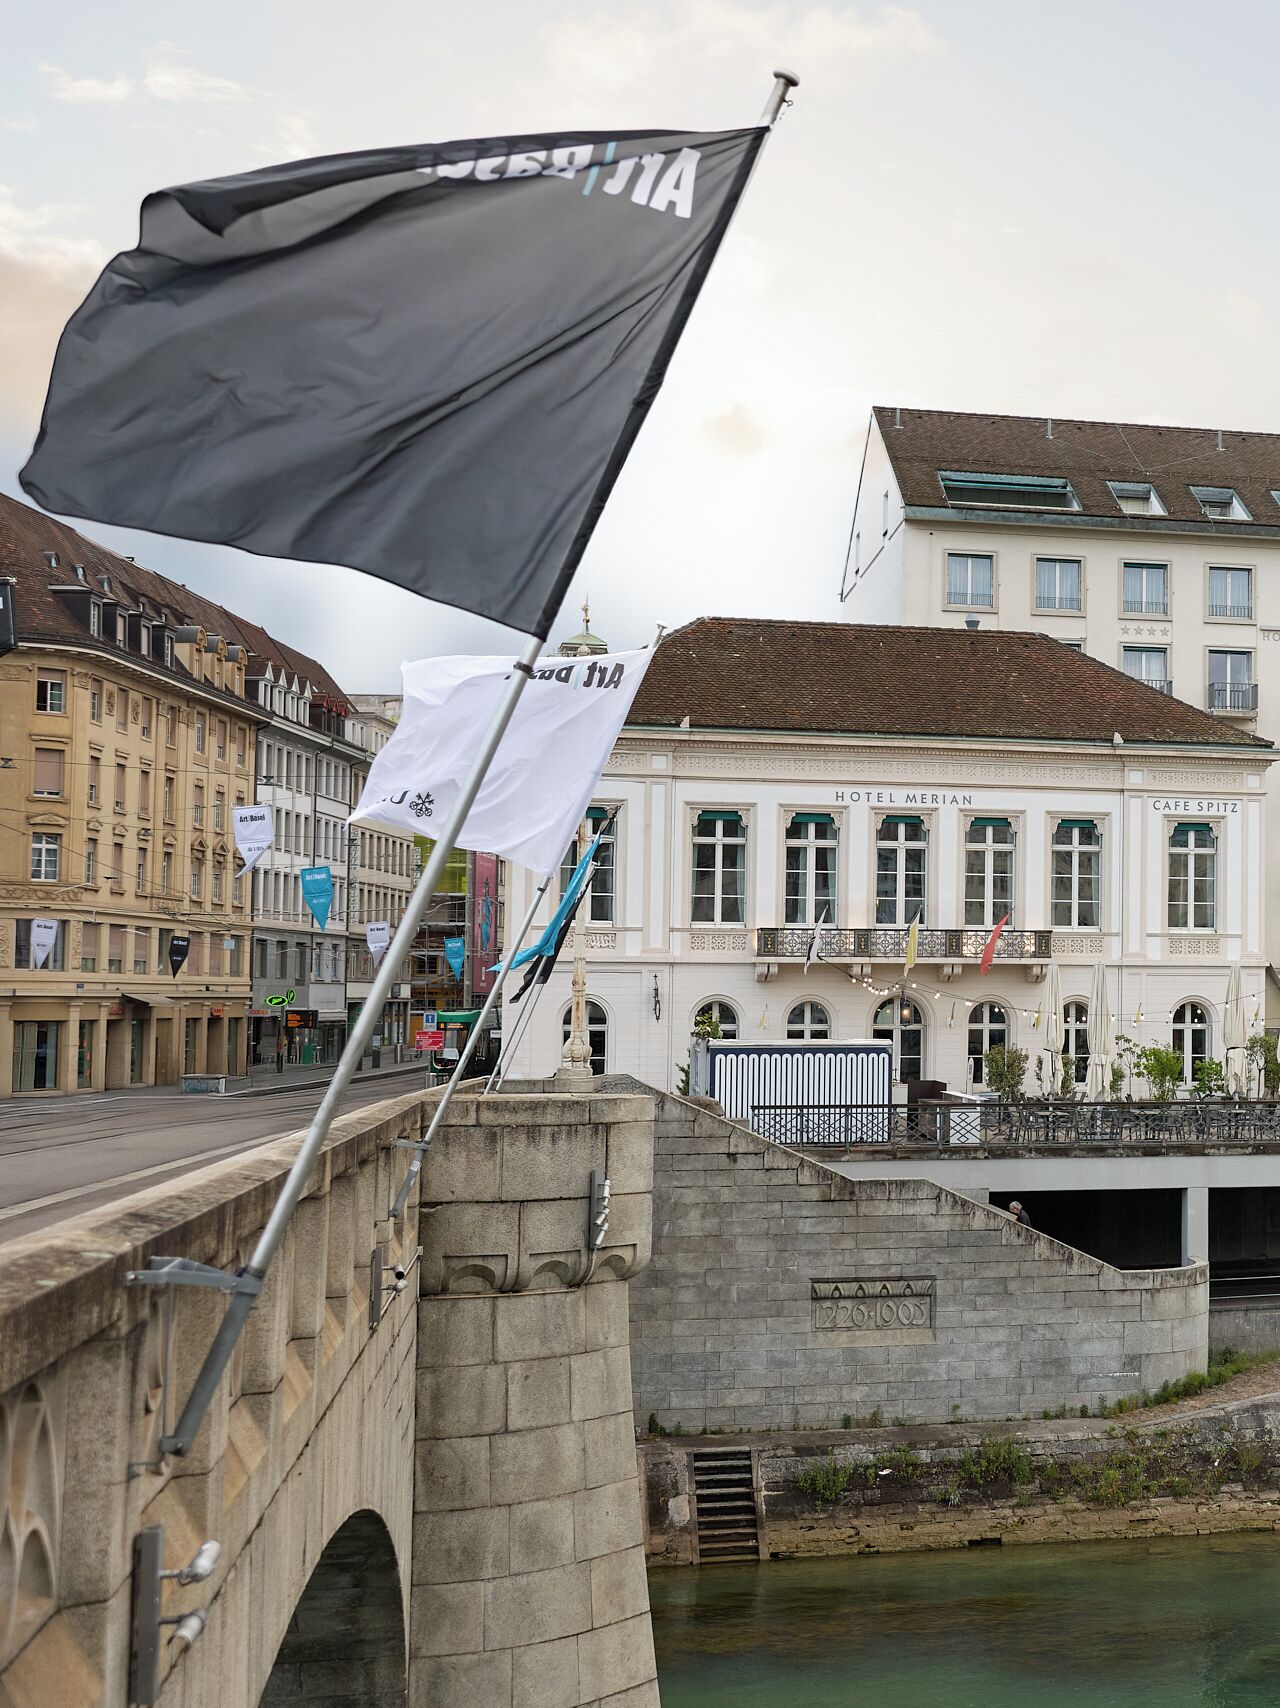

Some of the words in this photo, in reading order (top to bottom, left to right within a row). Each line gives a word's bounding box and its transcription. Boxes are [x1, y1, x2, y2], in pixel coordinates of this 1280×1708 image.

[835, 791, 895, 803] HOTEL
[905, 793, 973, 805] MERIAN
[1153, 800, 1190, 811] CAFE
[1197, 801, 1238, 813] SPITZ
[814, 1301, 868, 1329] 1226
